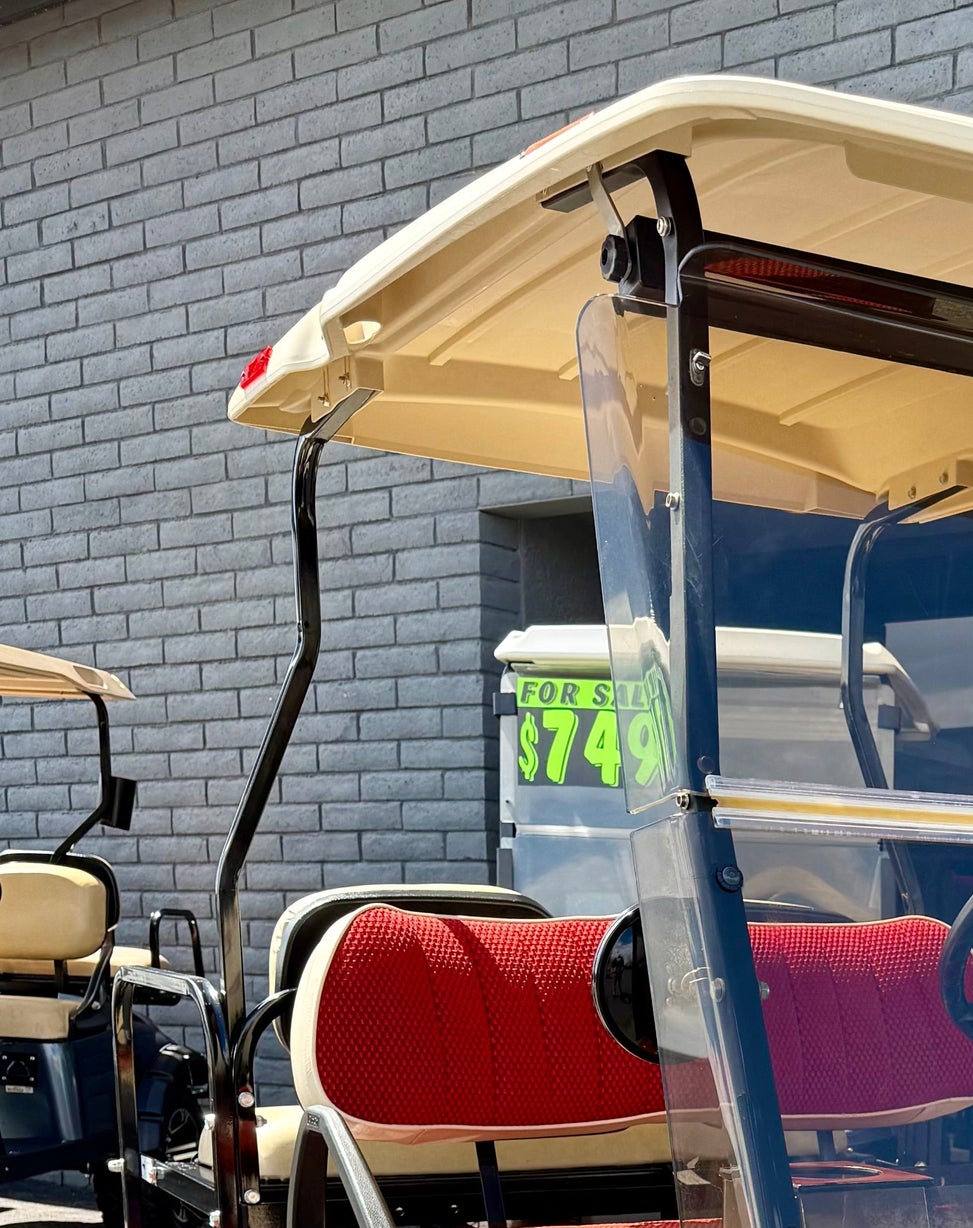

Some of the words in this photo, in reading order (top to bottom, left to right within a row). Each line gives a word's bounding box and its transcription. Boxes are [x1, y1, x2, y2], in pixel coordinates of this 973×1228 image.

[520, 681, 580, 706] FOR
[592, 683, 648, 708] SAL
[518, 709, 664, 787] $749
